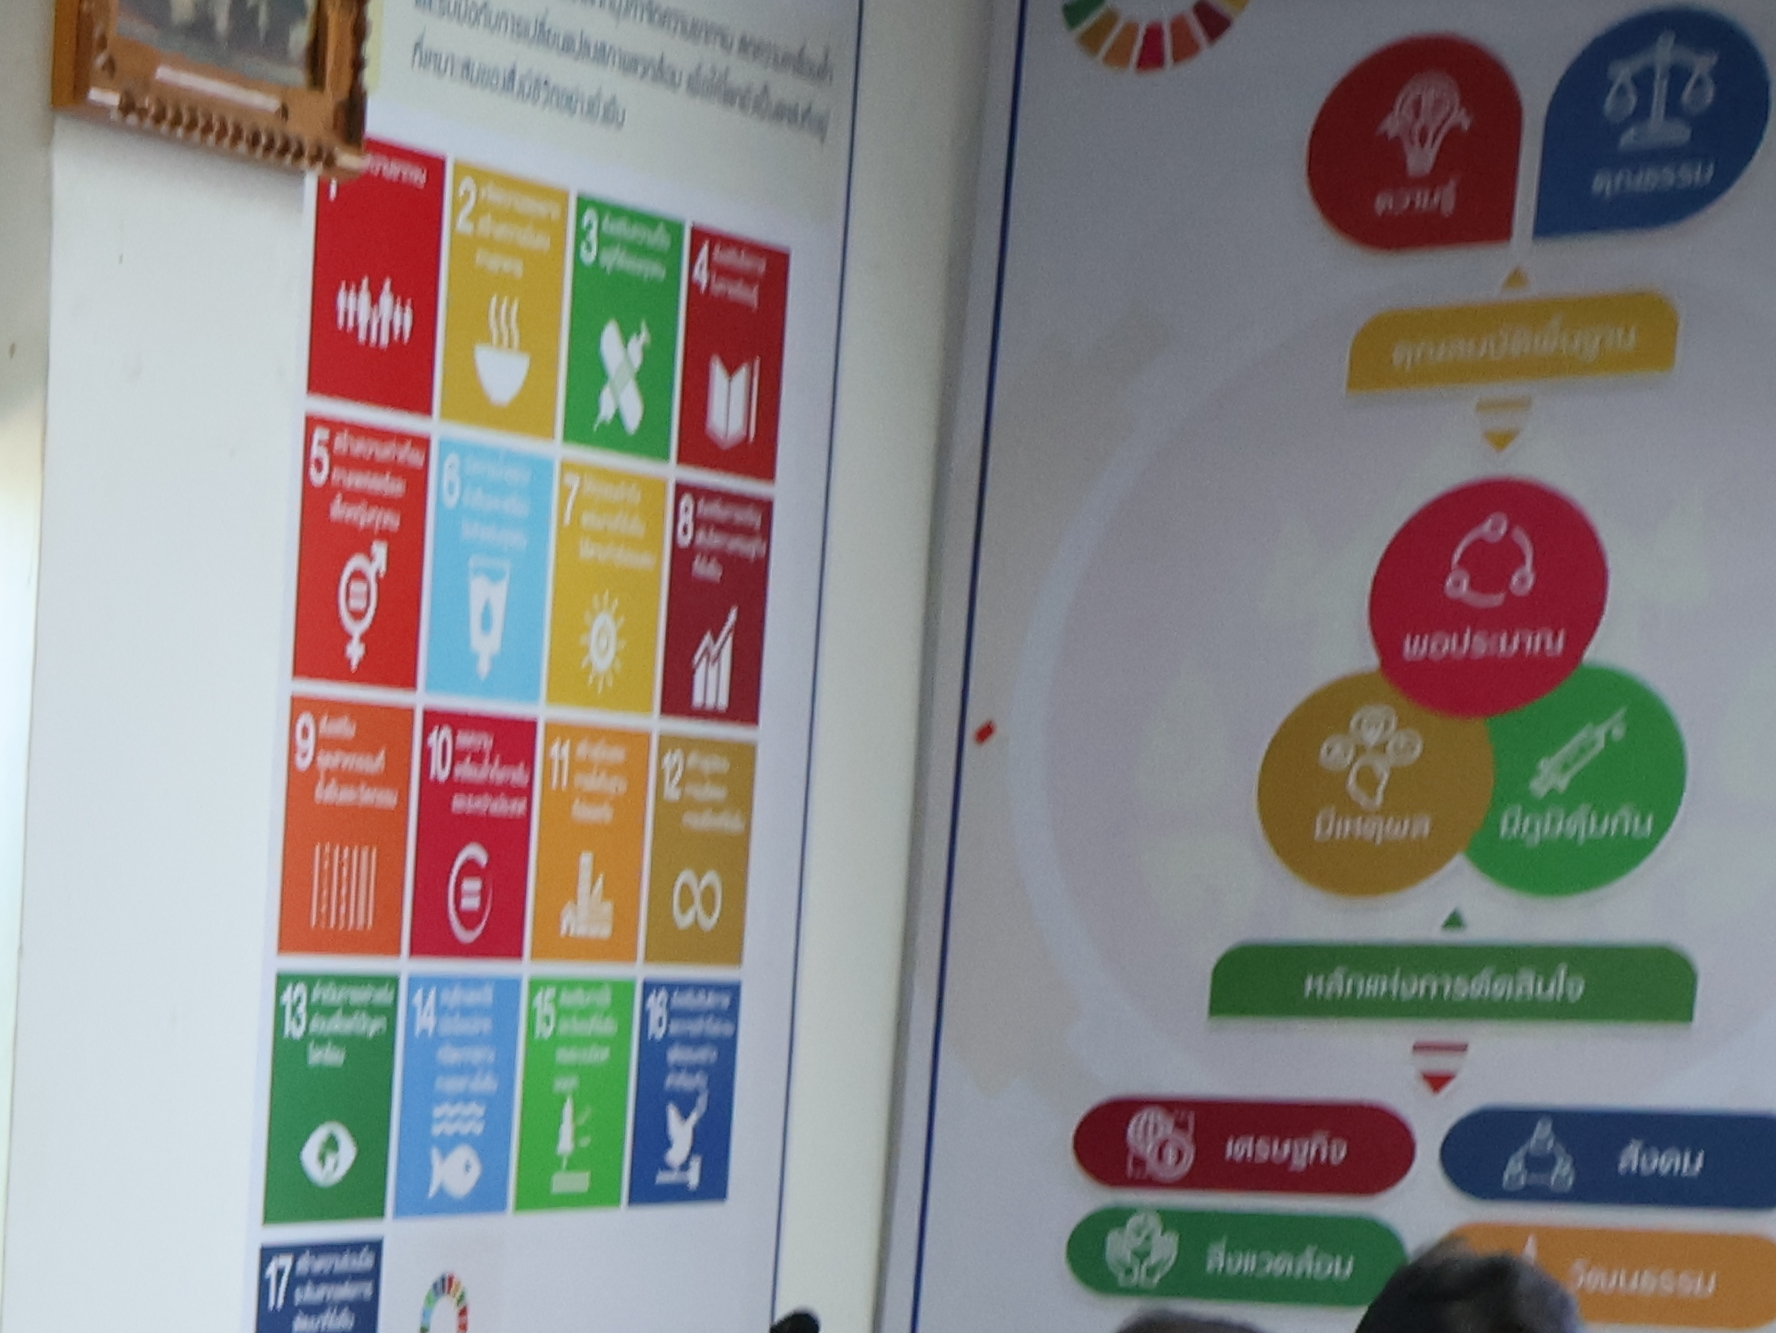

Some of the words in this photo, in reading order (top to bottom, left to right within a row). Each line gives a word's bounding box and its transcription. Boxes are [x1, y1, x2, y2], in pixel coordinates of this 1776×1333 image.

[456, 176, 478, 235] 2
[1590, 158, 1716, 200] คุณธรรม
[580, 207, 599, 266] 3
[692, 240, 710, 295] 4
[309, 426, 331, 488] 5
[442, 452, 461, 509] 6
[564, 472, 580, 527] 7
[677, 493, 695, 549] 8
[1401, 625, 1567, 662] พอประมาณ
[294, 711, 316, 772] 9
[427, 725, 454, 784] 10
[550, 737, 571, 792] 11
[662, 748, 685, 802] 12
[1313, 803, 1433, 846] มีเหตุผล
[280, 981, 309, 1040] 13
[412, 986, 438, 1039] 14
[533, 986, 557, 1041] 15
[1224, 1132, 1350, 1173] เศรษฐกิจ
[1616, 1136, 1705, 1179] สังคม
[265, 1254, 295, 1313] 17
[1205, 1234, 1356, 1282] สิ่งแวดล้อม
